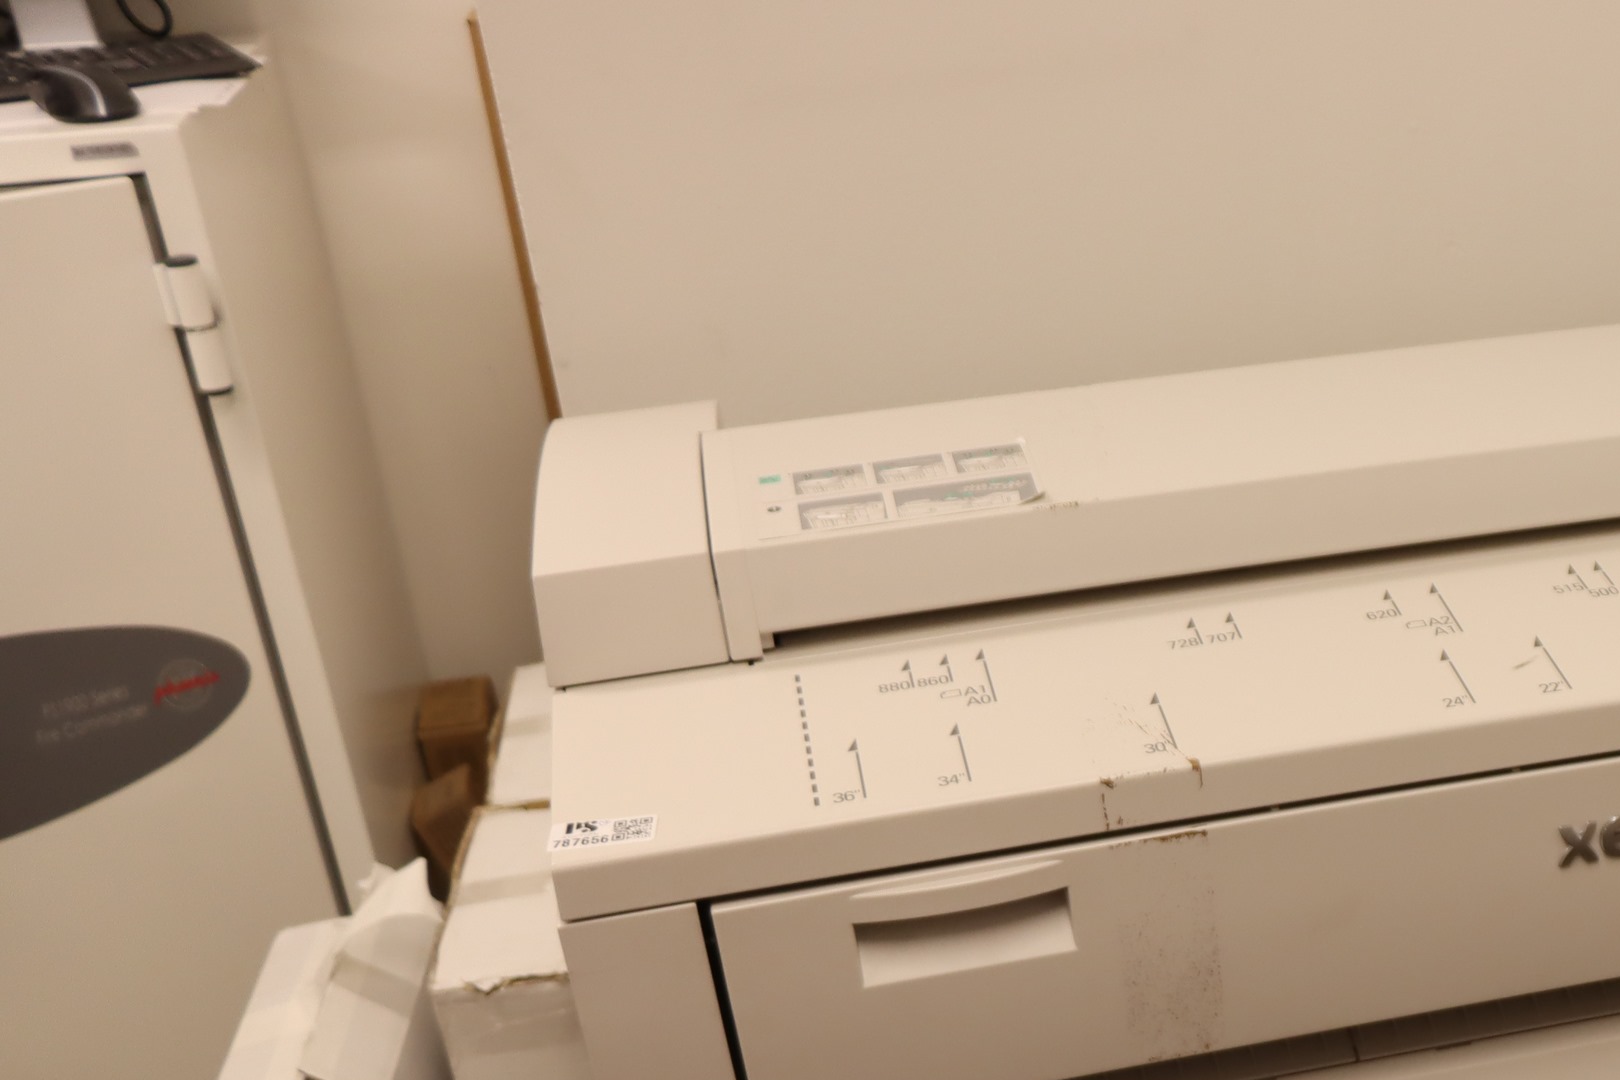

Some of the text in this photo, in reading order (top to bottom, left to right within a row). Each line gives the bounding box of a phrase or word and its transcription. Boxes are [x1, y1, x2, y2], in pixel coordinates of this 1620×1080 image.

[1553, 582, 1585, 594] 515
[1588, 585, 1620, 598] 500
[1366, 608, 1398, 621] 620
[1429, 615, 1451, 627] A2
[1434, 625, 1457, 637] A1
[1168, 637, 1200, 650] 728
[1206, 632, 1236, 644] 707
[878, 681, 911, 694] 880
[917, 675, 949, 688] 860
[964, 684, 986, 697] A1
[938, 772, 966, 787] 34"
[832, 788, 861, 804] 36"
[553, 835, 609, 848] 787656
